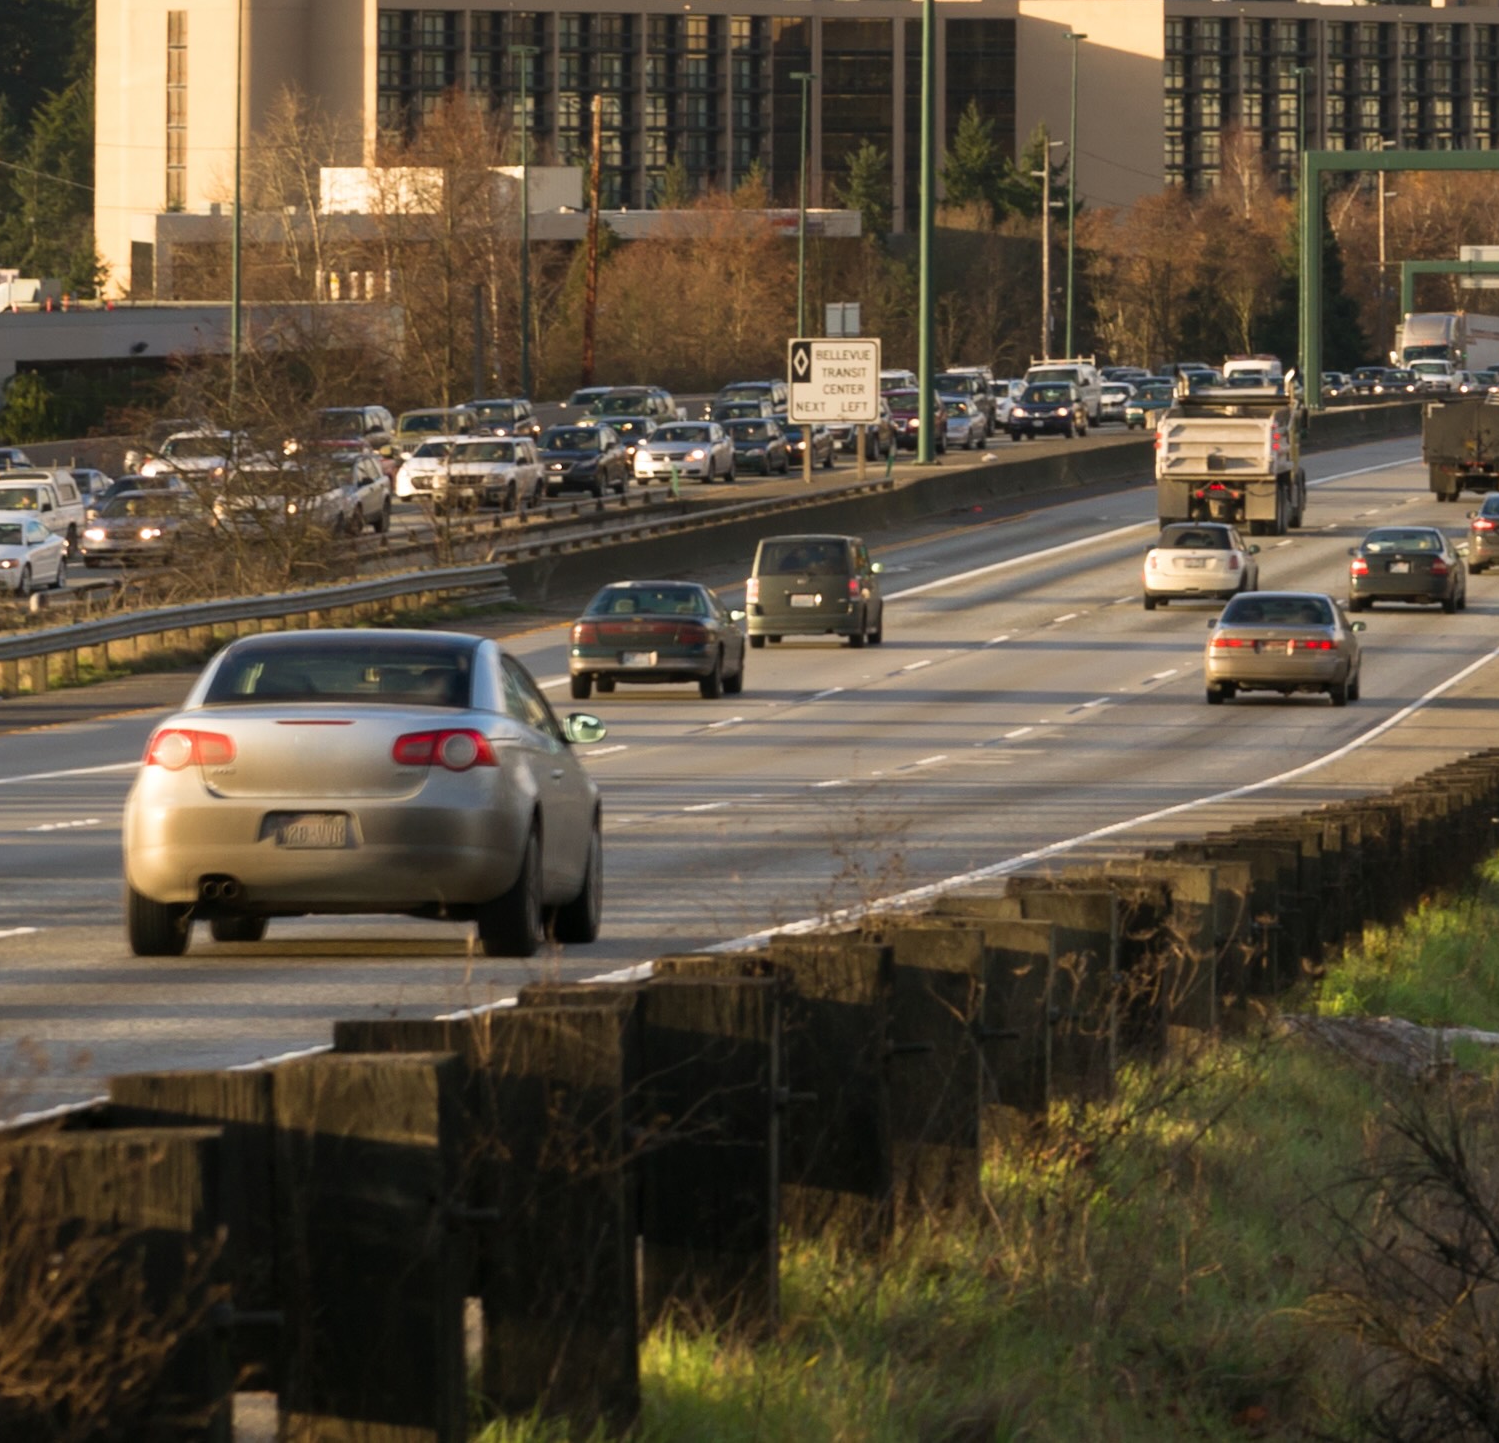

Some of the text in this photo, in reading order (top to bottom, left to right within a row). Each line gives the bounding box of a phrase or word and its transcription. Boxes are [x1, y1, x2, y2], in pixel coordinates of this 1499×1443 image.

[815, 349, 871, 361] BELLEVUE
[821, 367, 868, 378] TRANSIT
[822, 384, 865, 395] CENTER
[796, 401, 868, 412] NEXT LEFT
